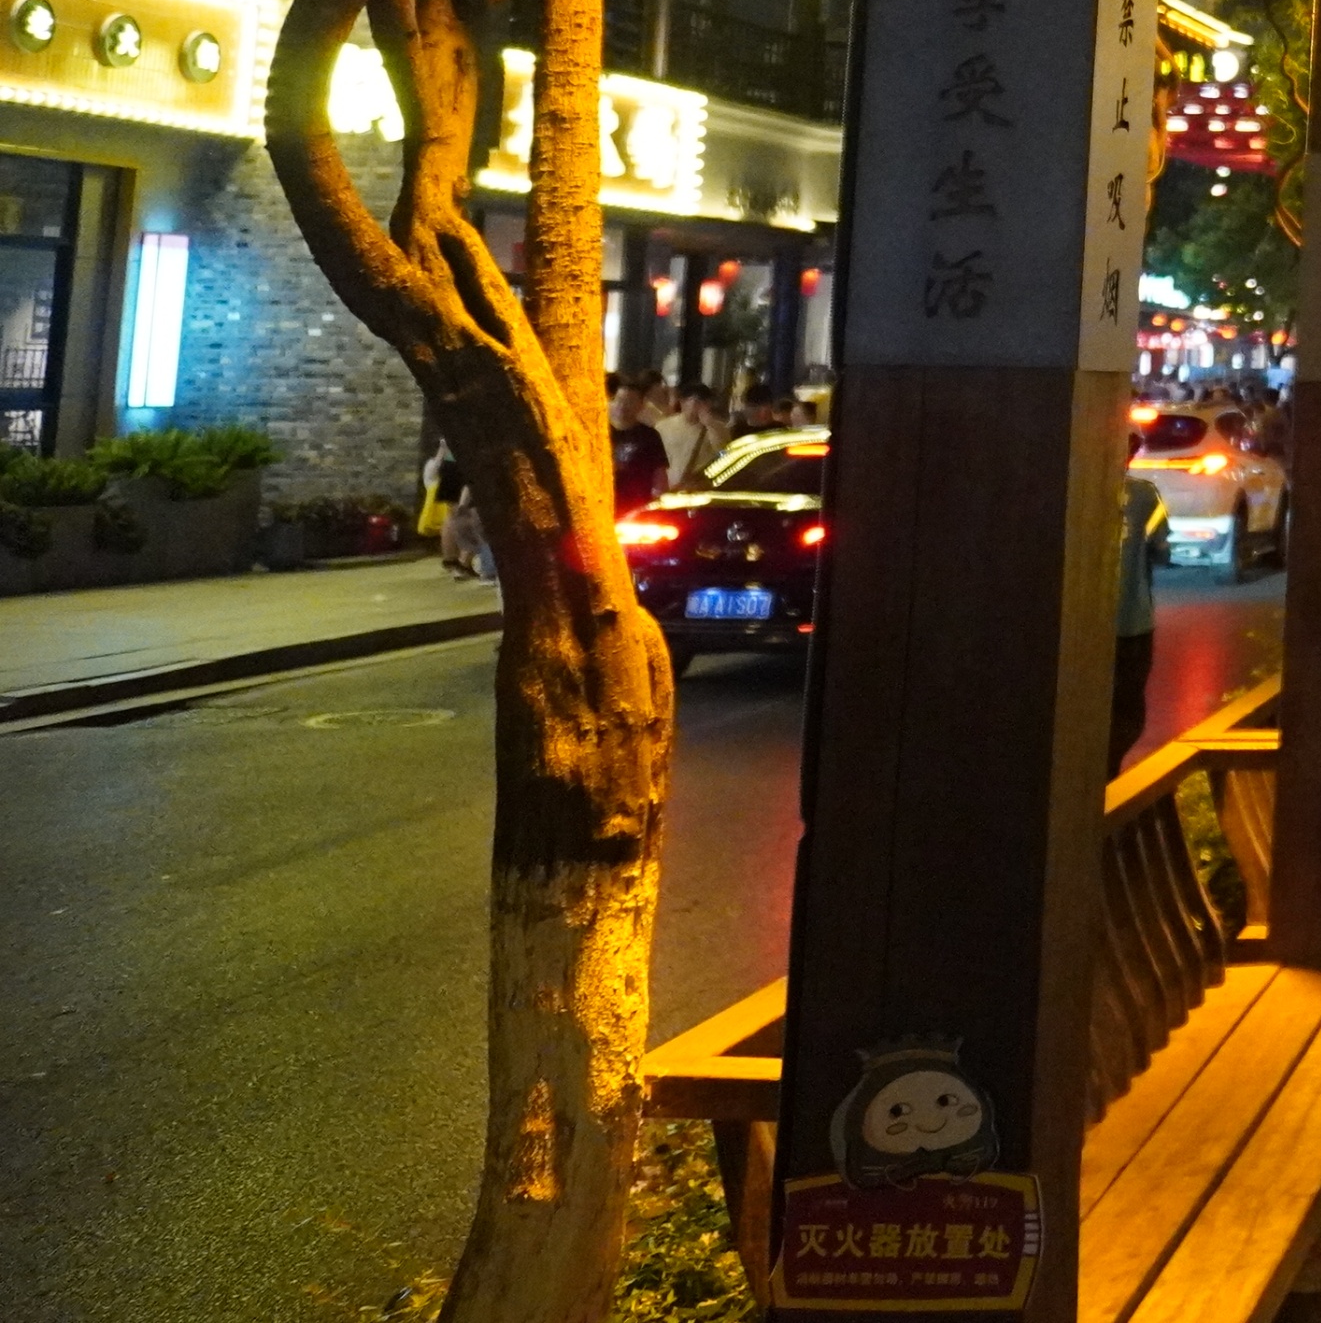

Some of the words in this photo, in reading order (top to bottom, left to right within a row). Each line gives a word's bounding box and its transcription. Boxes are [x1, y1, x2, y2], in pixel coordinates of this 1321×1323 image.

[796, 1223, 1012, 1259] 灭火器放置处
